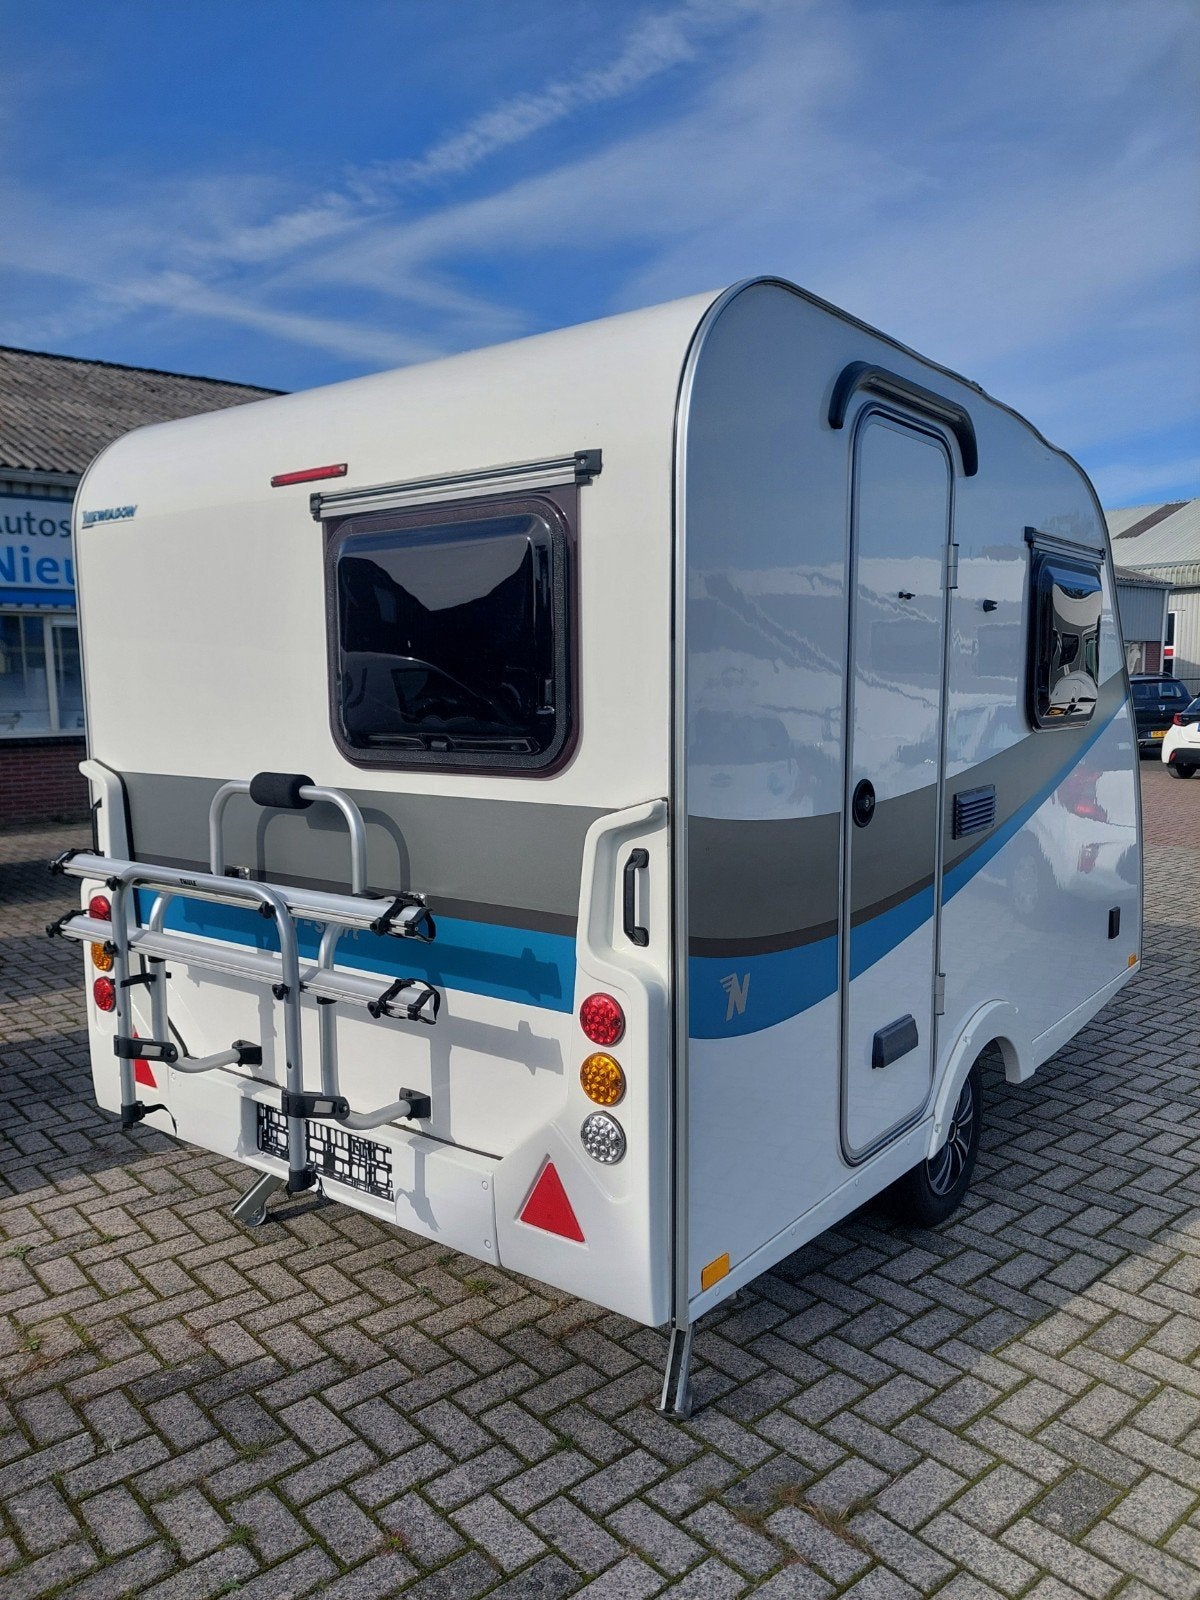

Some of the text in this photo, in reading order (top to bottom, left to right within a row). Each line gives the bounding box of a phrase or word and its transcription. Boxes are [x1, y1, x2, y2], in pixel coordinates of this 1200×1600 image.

[0, 512, 72, 538] utos
[179, 877, 198, 887] THULE
[720, 972, 750, 1022] N
